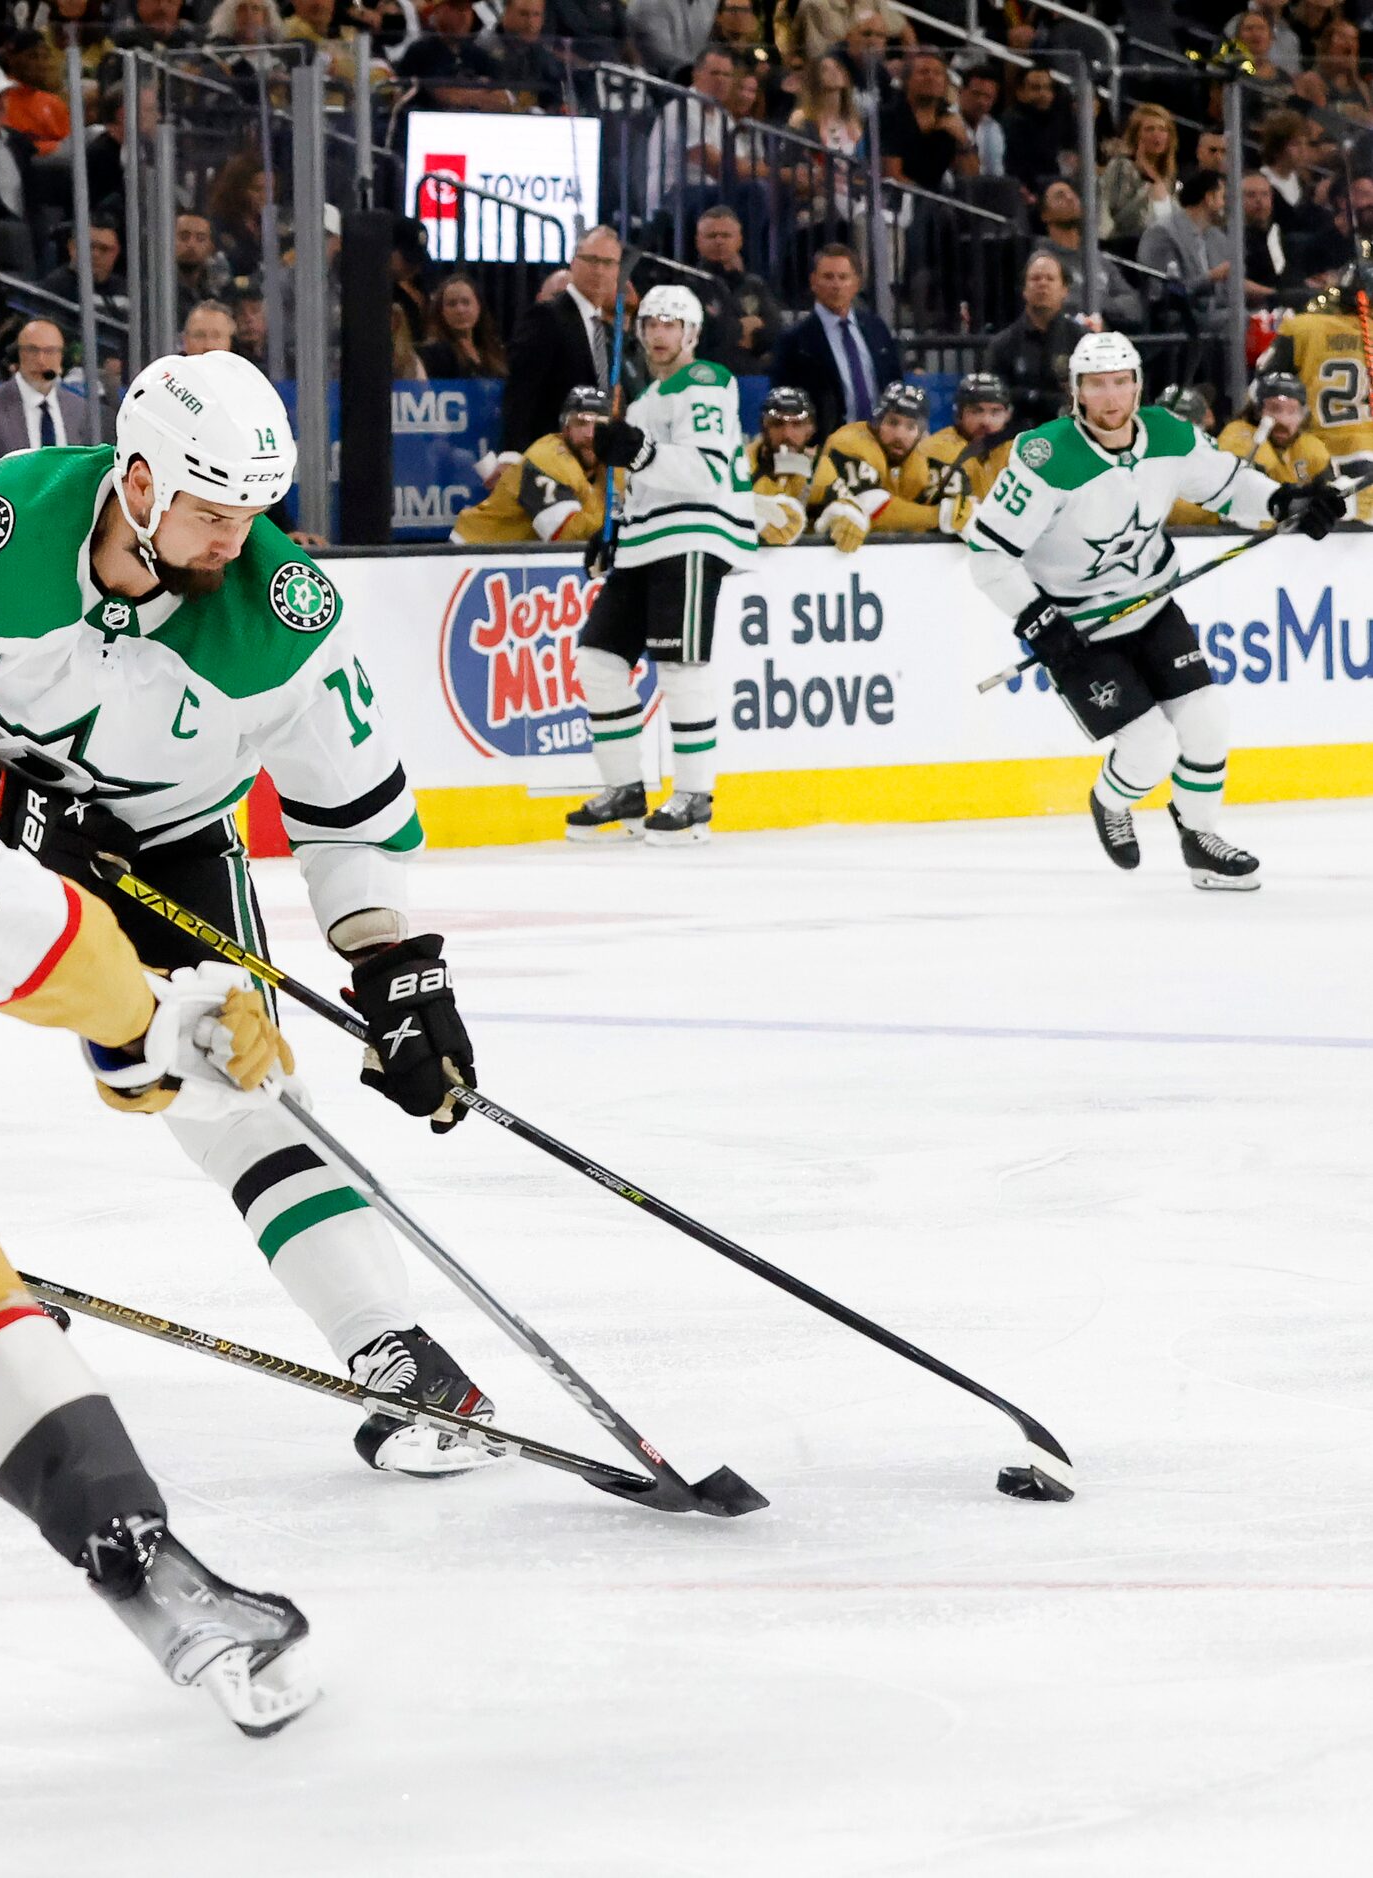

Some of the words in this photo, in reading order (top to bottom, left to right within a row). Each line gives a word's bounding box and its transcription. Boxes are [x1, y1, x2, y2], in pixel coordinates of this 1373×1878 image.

[479, 173, 582, 203] TOYOTA
[1318, 357, 1373, 428] 2
[692, 402, 724, 434] 23
[255, 427, 277, 451] 14
[243, 471, 285, 482] CCM
[740, 594, 769, 646] a
[791, 572, 884, 645] sub
[1024, 605, 1057, 641] CC
[1174, 649, 1204, 669] CC
[171, 684, 200, 740] C
[732, 657, 894, 731] above
[133, 882, 247, 962] VAPOR
[447, 1085, 515, 1128] BAUER
[640, 1440, 663, 1464] CCM
